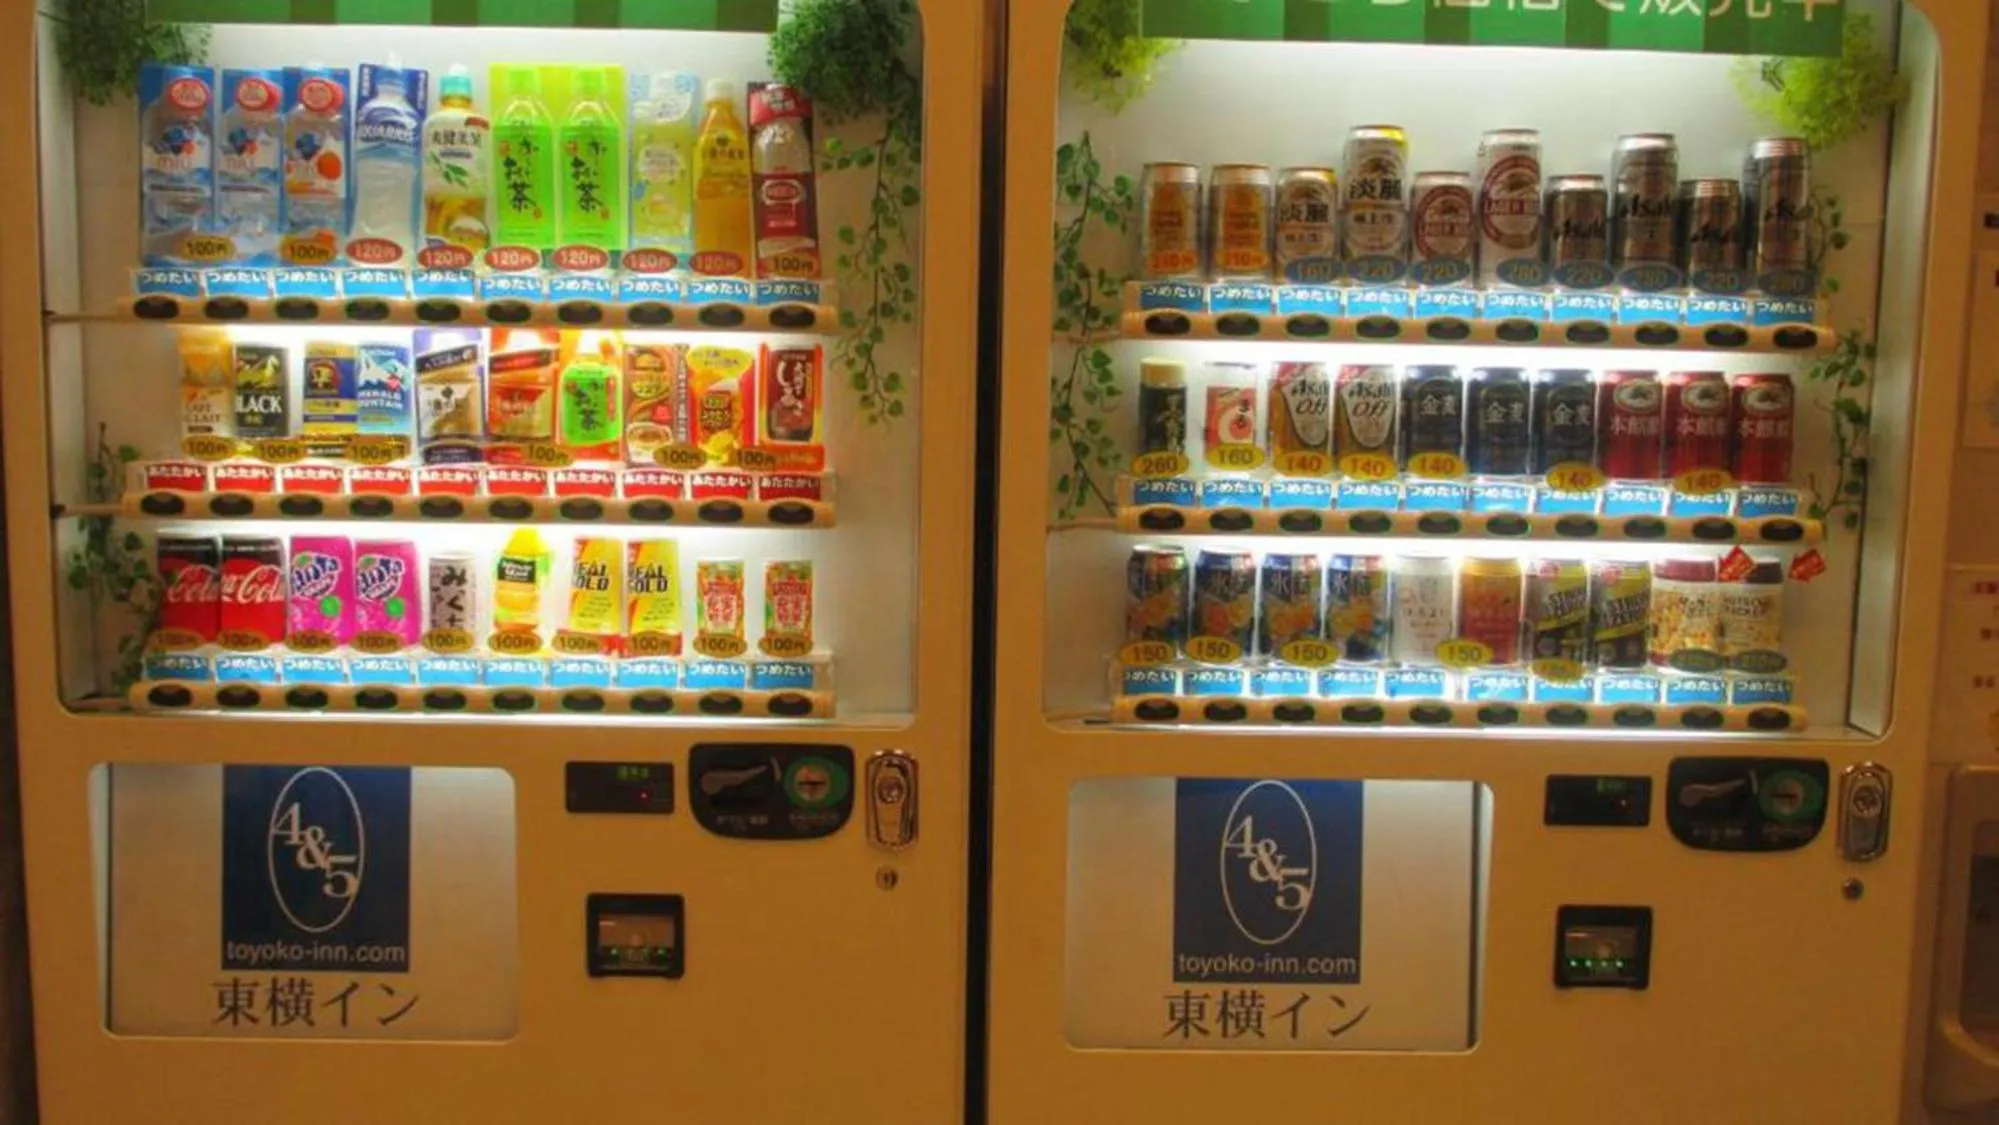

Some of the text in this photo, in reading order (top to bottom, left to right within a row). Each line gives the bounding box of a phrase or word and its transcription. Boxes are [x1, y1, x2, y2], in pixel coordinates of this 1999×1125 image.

[186, 240, 230, 256] 100円
[290, 244, 332, 259] 100円
[354, 243, 397, 258] 120円
[425, 249, 466, 264] 120円
[492, 250, 533, 265] 120円
[560, 250, 600, 265] 120円
[630, 252, 674, 268] 120円
[772, 255, 814, 272] 100円
[141, 271, 198, 285] つめたい
[206, 270, 267, 283] つめたい
[276, 270, 336, 284] つめたい
[346, 269, 406, 283] つめたい
[417, 270, 472, 283] つめたい
[485, 278, 542, 291] つめたい
[552, 279, 611, 293] つめたい
[622, 281, 681, 294] つめたい
[691, 282, 750, 296] つめたい
[759, 284, 818, 298] つめたい
[1146, 286, 1201, 298] つめたい
[1214, 287, 1271, 299] つめたい
[1281, 288, 1339, 301] つめたい
[1352, 291, 1408, 304] つめたい
[1420, 293, 1478, 305] つめたい
[1488, 294, 1545, 306] つめたい
[1556, 295, 1612, 308] つめたい
[1624, 297, 1680, 309] つめたい
[1691, 300, 1747, 312] つめたい
[1757, 301, 1813, 313] つめたい
[1292, 379, 1330, 397] Asahi
[1348, 380, 1392, 397] Asahi
[236, 395, 282, 414] LACK
[1296, 399, 1326, 415] Off
[1352, 400, 1389, 417] Off
[1419, 395, 1456, 416] 金麦
[1486, 401, 1525, 423] 金麦
[1553, 402, 1592, 426] 金麦
[188, 440, 228, 456] 100円
[260, 442, 299, 457] 100円
[352, 445, 393, 459] 100円
[528, 444, 570, 461] 100円
[665, 450, 701, 464] 100円
[737, 450, 776, 466] 100円
[1219, 450, 1254, 465] 160
[1287, 455, 1322, 471] 140
[1143, 458, 1178, 474] 260
[1351, 457, 1386, 476] 140
[1421, 456, 1456, 473] 140
[149, 466, 205, 478] あたたかい
[214, 466, 274, 479] あたたかい
[281, 467, 343, 480] あたたかい
[352, 468, 412, 480] あたたかい
[420, 469, 480, 481] あたたかい
[487, 470, 546, 482] あたたかい
[555, 471, 614, 483] あたたかい
[623, 474, 684, 486] あたたかい
[692, 475, 752, 487] あたたかい
[760, 476, 820, 488] あたたかい
[1558, 471, 1593, 488] 140
[1139, 482, 1195, 493] つめたい
[1207, 482, 1263, 494] つめたい
[1275, 483, 1330, 494] つめたい
[1343, 484, 1398, 496] つめたい
[1410, 485, 1466, 497] つめたい
[1474, 487, 1530, 499] つめたい
[1607, 491, 1663, 503] つめたい
[1742, 493, 1797, 505] つめたい
[576, 561, 607, 577] EAL
[575, 576, 609, 591] OLD
[358, 635, 398, 647] 100円
[428, 635, 467, 647] 100円
[495, 635, 535, 647] 100円
[560, 636, 599, 649] 100円
[632, 636, 671, 649] 100円
[700, 637, 739, 651] 100円
[768, 638, 806, 651] 100円
[1133, 646, 1168, 662] 150
[1196, 640, 1231, 657] 150
[1293, 645, 1329, 661] 150
[1449, 648, 1483, 663] 150
[155, 656, 208, 669] つめたい
[220, 656, 277, 669] つめたい
[284, 657, 341, 670] つめたい
[352, 659, 409, 671] つめたい
[418, 660, 478, 672] つめたい
[487, 661, 542, 673] つめたい
[554, 662, 611, 674] つめたい
[620, 663, 677, 676] つめたい
[690, 664, 746, 675] つめたい
[757, 665, 812, 676] つめたい
[1125, 671, 1175, 682] つめたい
[1190, 671, 1243, 683] つめたい
[1255, 671, 1311, 683] つめたい
[1321, 671, 1377, 683] つめたい
[1388, 672, 1445, 684] つめたい
[1469, 676, 1529, 688] つめたい
[1603, 677, 1660, 689] つめたい
[1673, 680, 1726, 692] つめたい
[1736, 681, 1791, 692] つめたい
[272, 801, 359, 899] 4&5
[1223, 814, 1312, 912] 4&5
[226, 940, 406, 964] toyoko-inn.com
[1178, 952, 1357, 977] toyoko-inn.com
[211, 977, 421, 1027] 東横イン
[1162, 989, 1371, 1041] 東横イン
